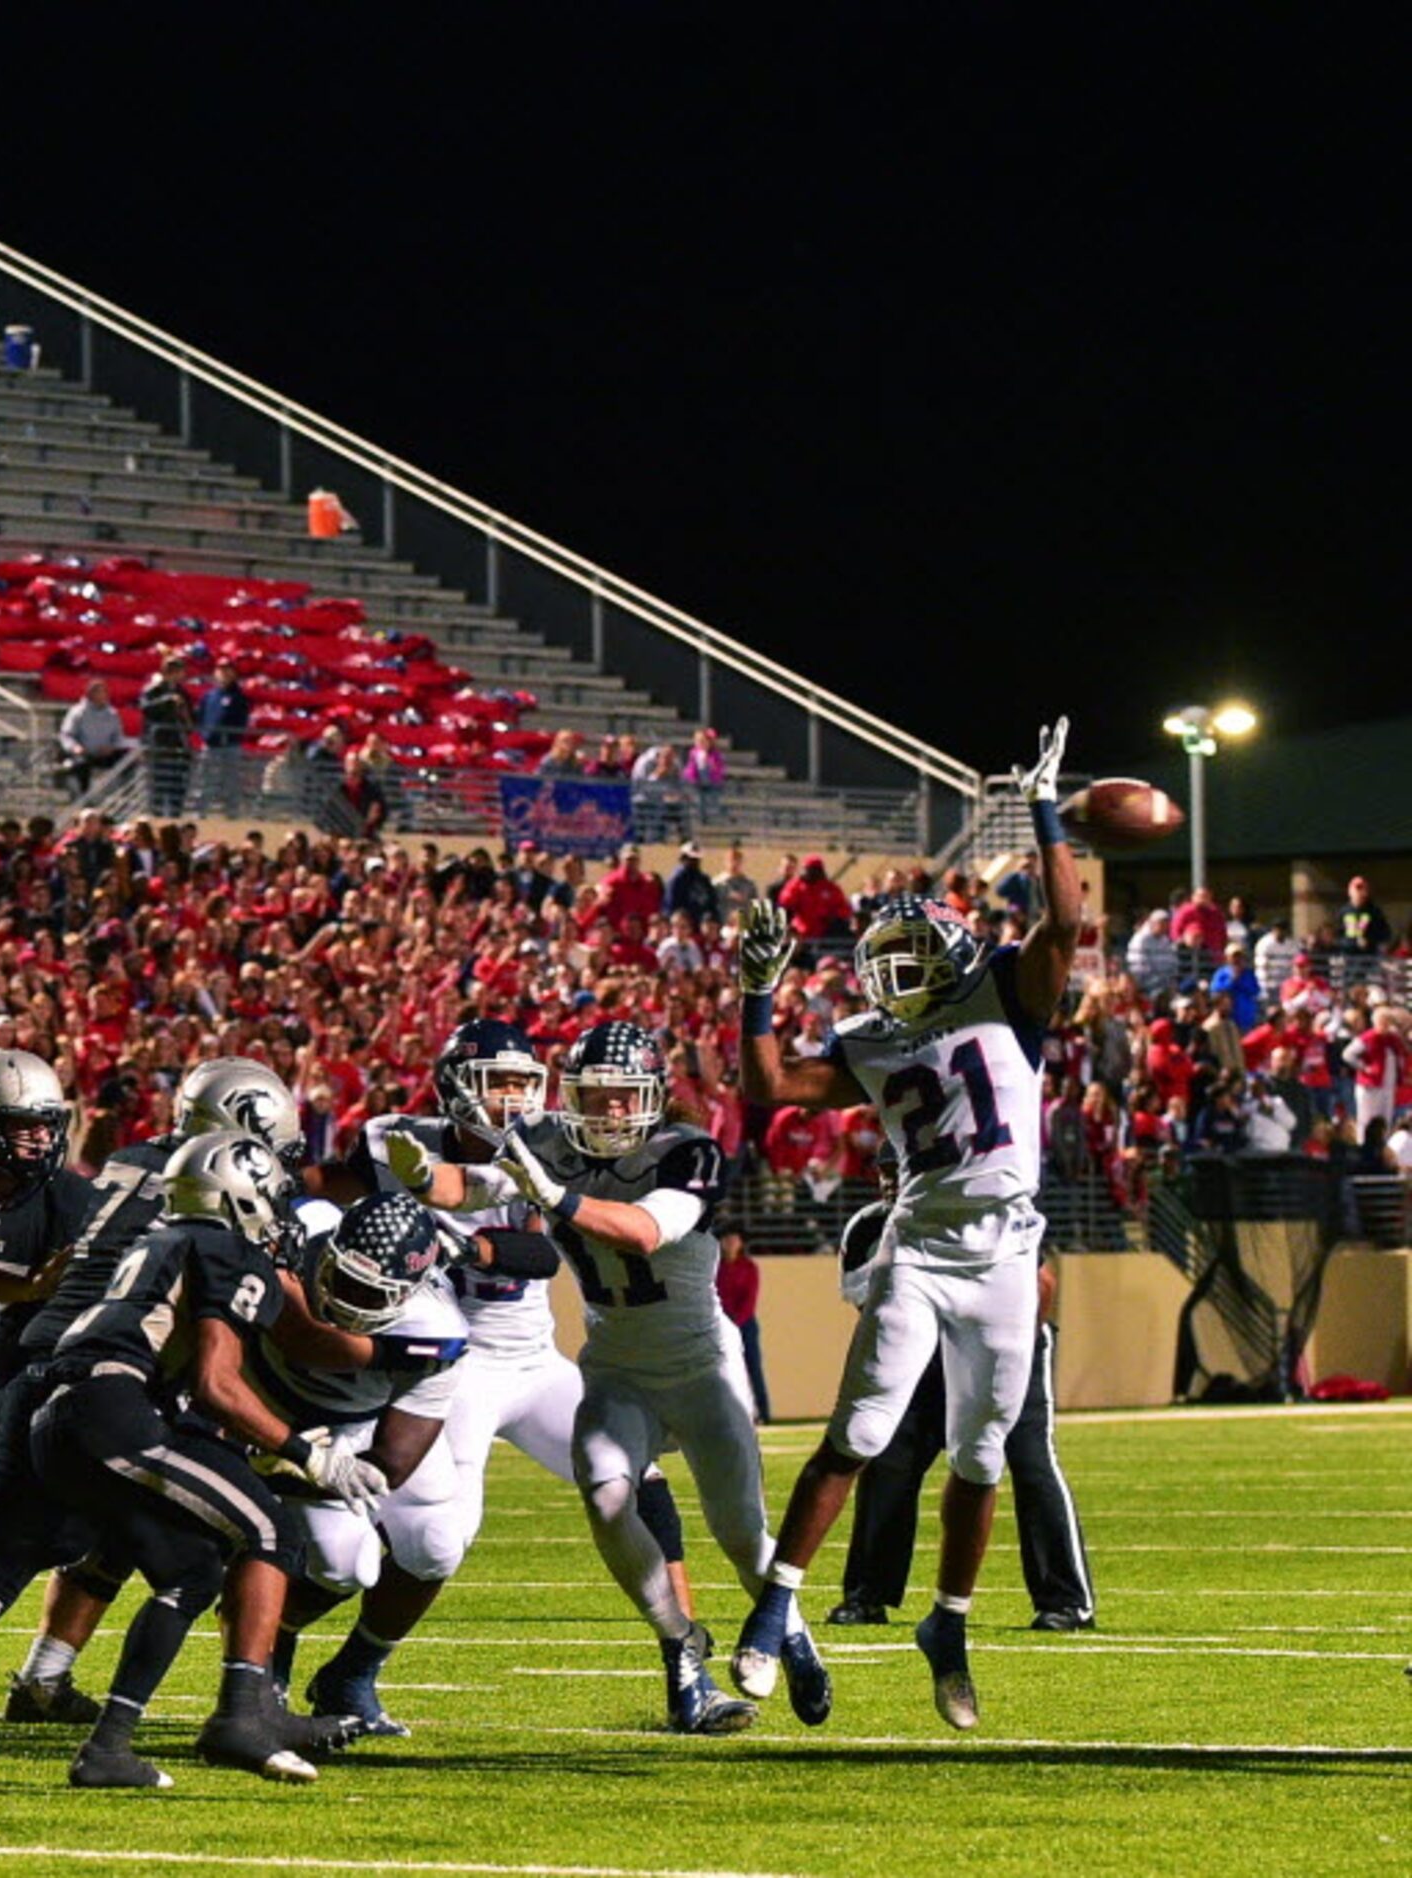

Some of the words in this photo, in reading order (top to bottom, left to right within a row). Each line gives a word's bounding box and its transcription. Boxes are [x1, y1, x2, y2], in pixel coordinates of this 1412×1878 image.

[883, 1037, 1013, 1174] 21
[688, 1145, 720, 1189] 11
[230, 1273, 266, 1323] 2
